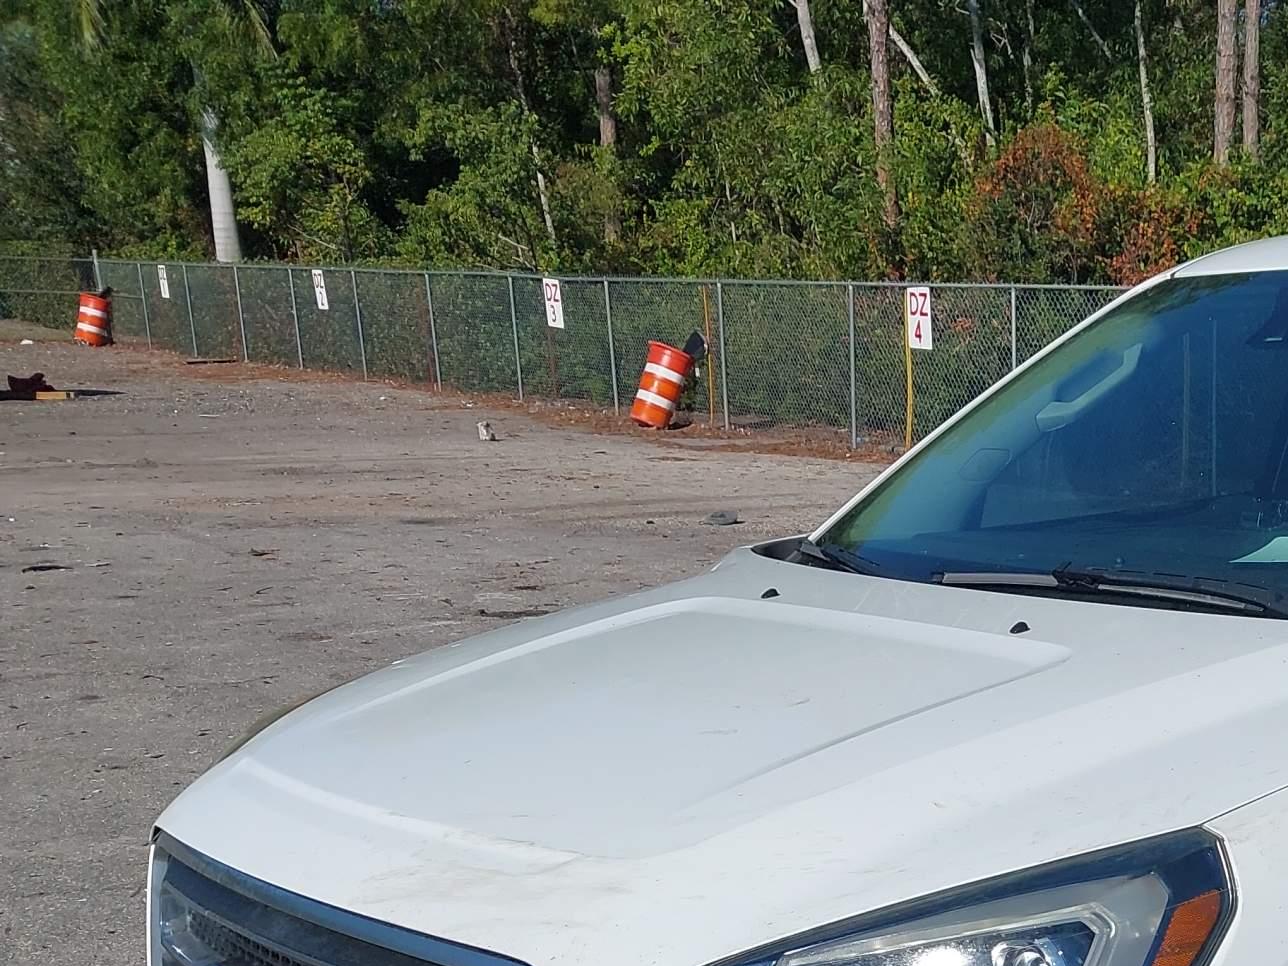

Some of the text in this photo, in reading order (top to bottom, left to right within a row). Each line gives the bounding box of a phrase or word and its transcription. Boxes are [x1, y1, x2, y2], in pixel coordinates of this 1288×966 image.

[313, 272, 324, 288] DZ
[544, 282, 560, 303] DZ
[549, 304, 557, 323] 3
[909, 291, 929, 317] DZ
[914, 319, 923, 345] 4
